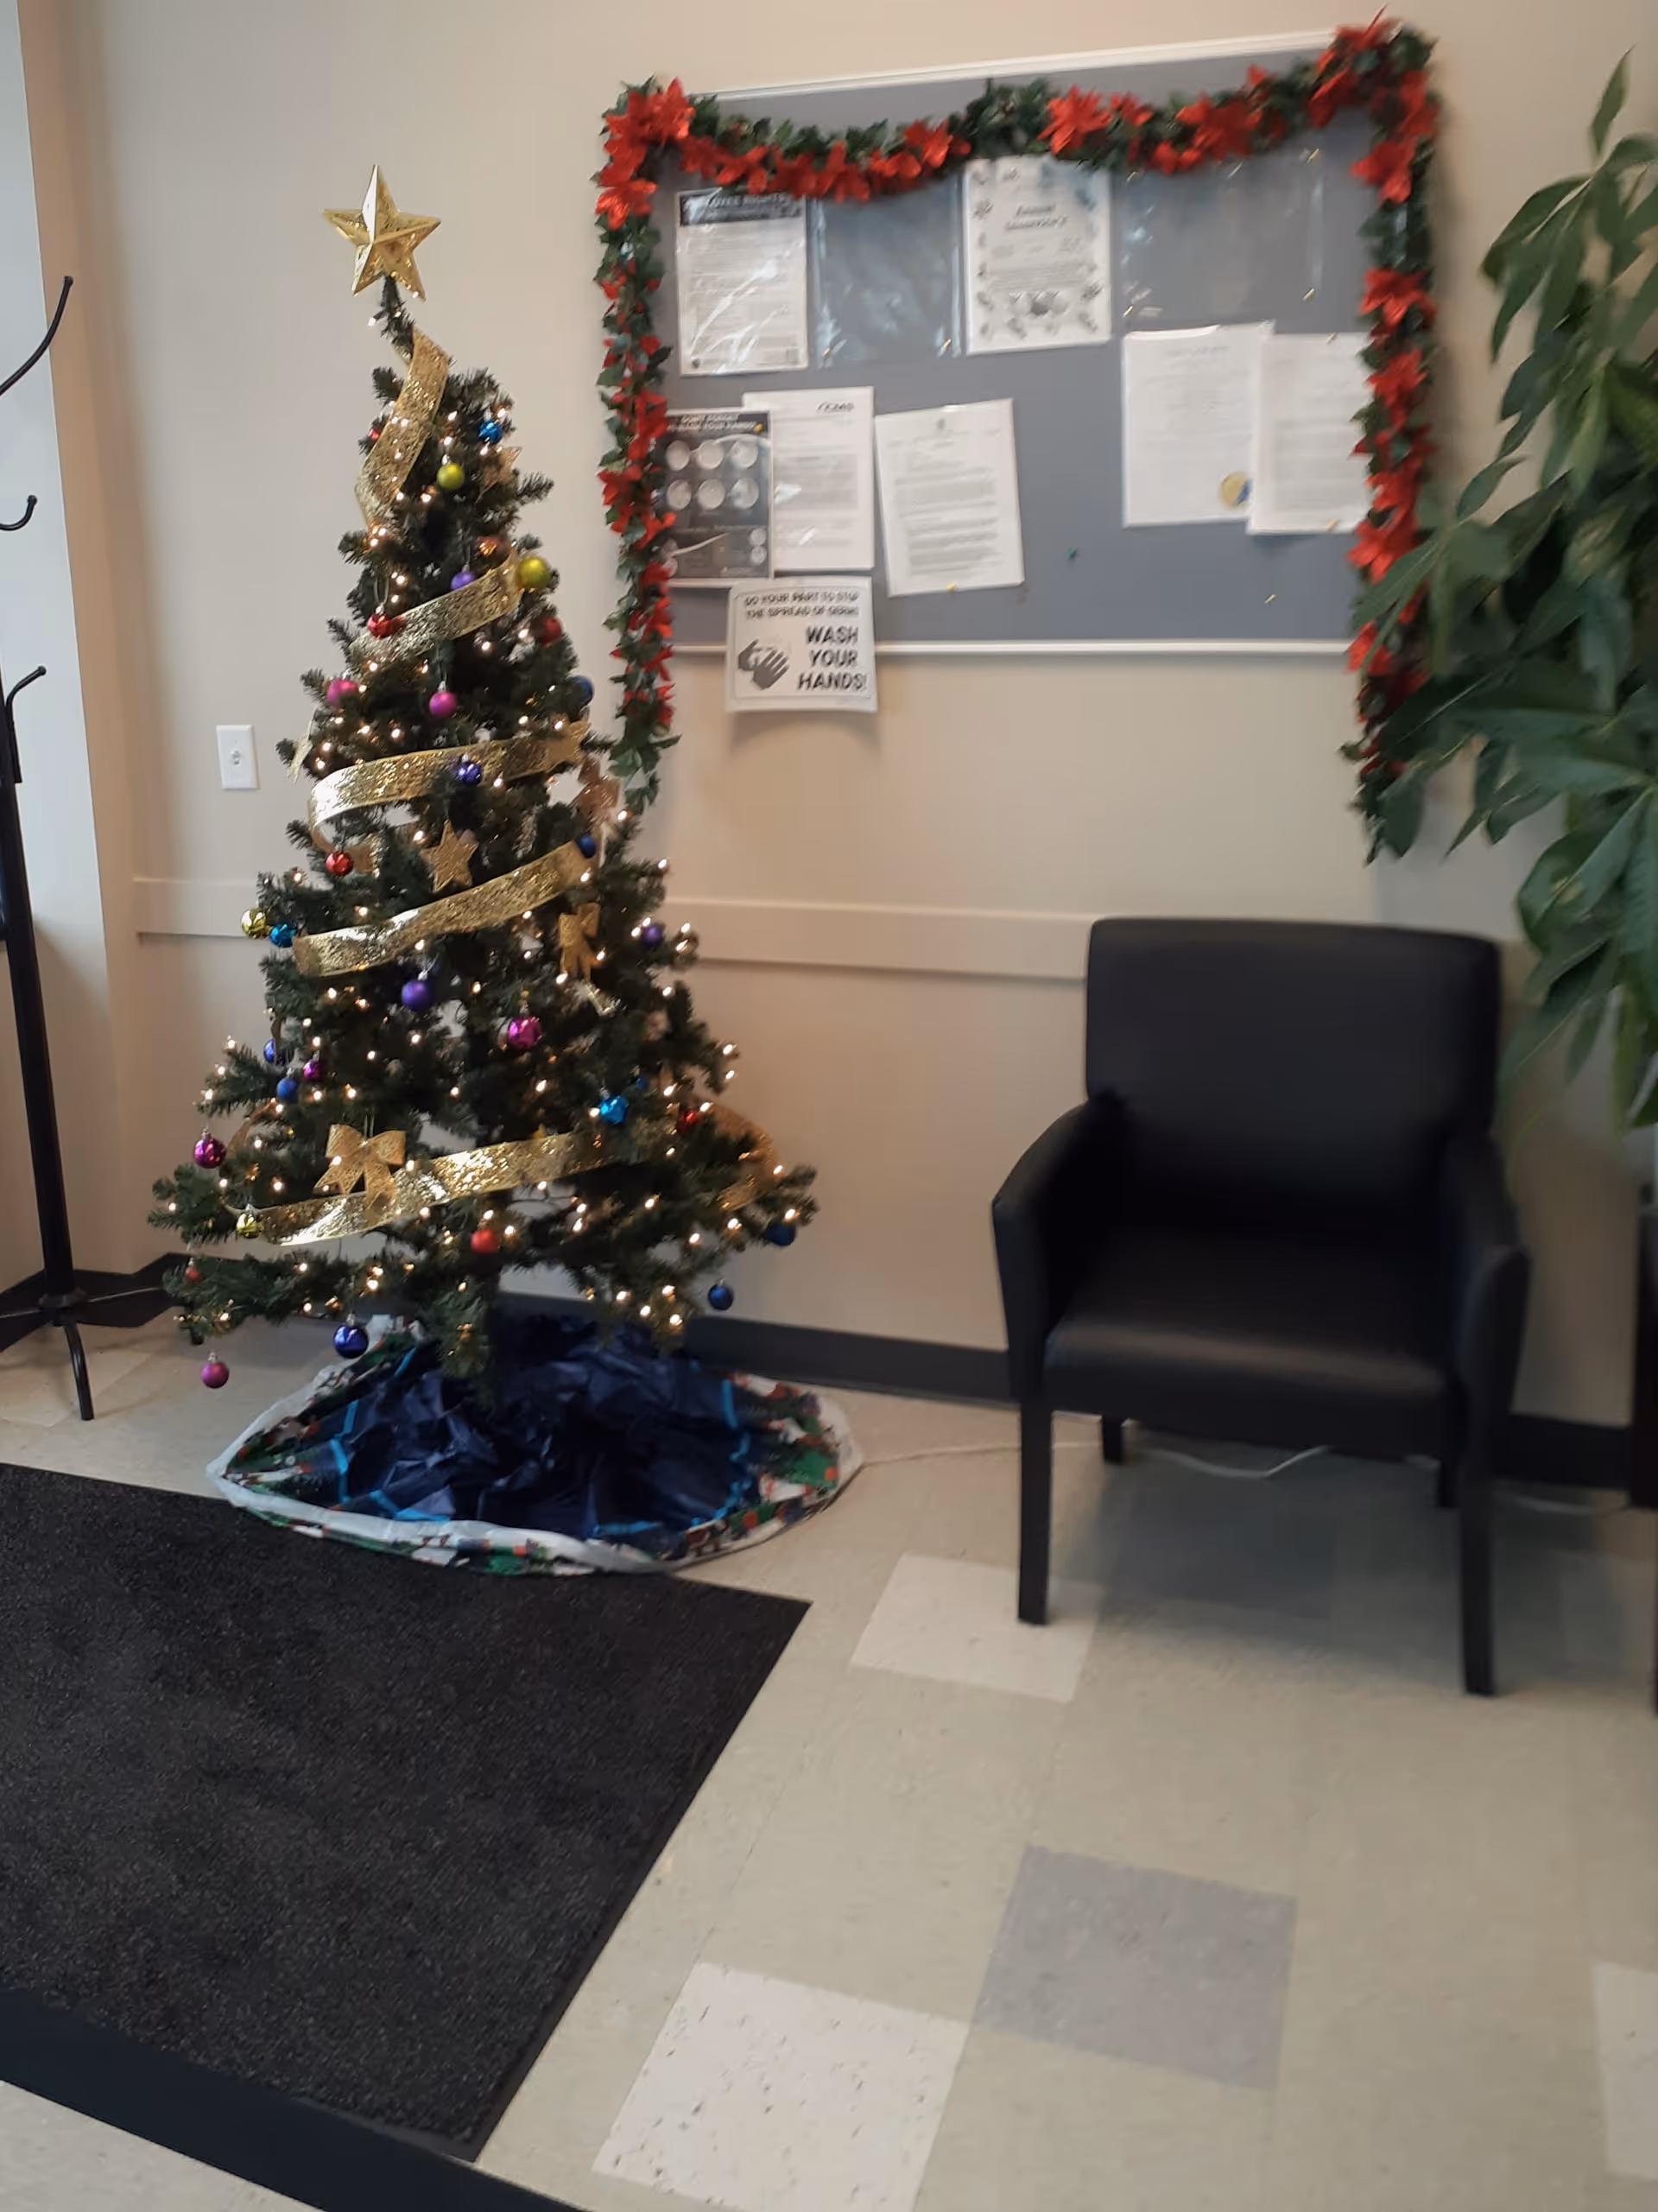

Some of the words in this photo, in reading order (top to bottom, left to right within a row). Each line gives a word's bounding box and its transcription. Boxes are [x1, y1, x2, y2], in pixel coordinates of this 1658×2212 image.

[744, 596, 758, 605] DO
[762, 593, 788, 604] YOUR
[792, 592, 818, 604] PART
[821, 592, 835, 603] TO
[746, 609, 763, 620] THE
[767, 606, 811, 618] SPREAD
[813, 605, 826, 615] OF
[806, 624, 858, 643] WASH
[810, 649, 858, 667] YOUR
[796, 673, 868, 690] HANDS!
